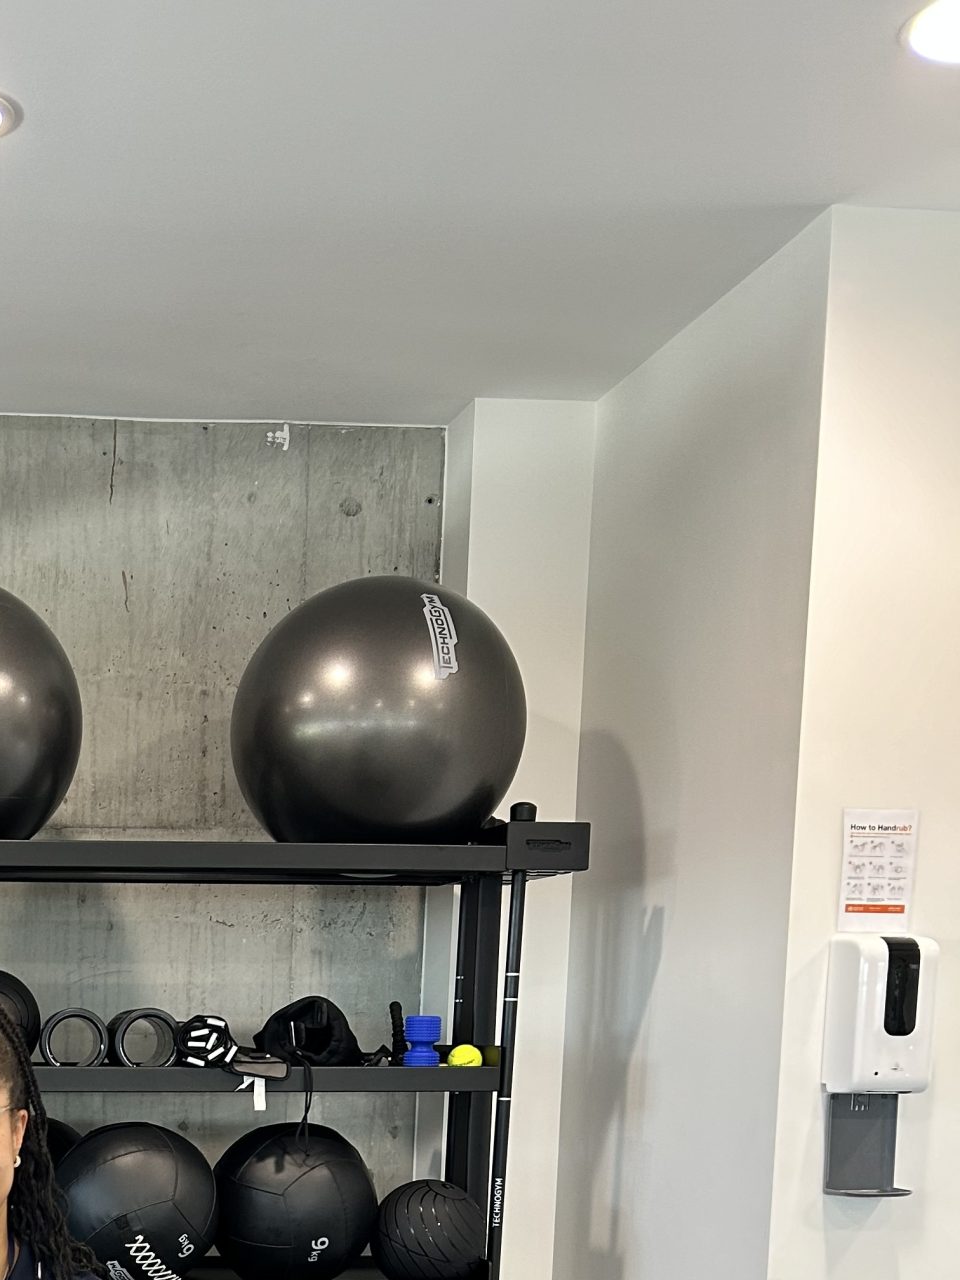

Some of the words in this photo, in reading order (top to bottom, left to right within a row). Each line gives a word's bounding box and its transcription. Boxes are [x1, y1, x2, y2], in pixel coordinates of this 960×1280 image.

[425, 595, 454, 669] TECHNOGYM
[877, 824, 913, 832] Handrub?
[492, 1177, 504, 1228] TECHNOGYM
